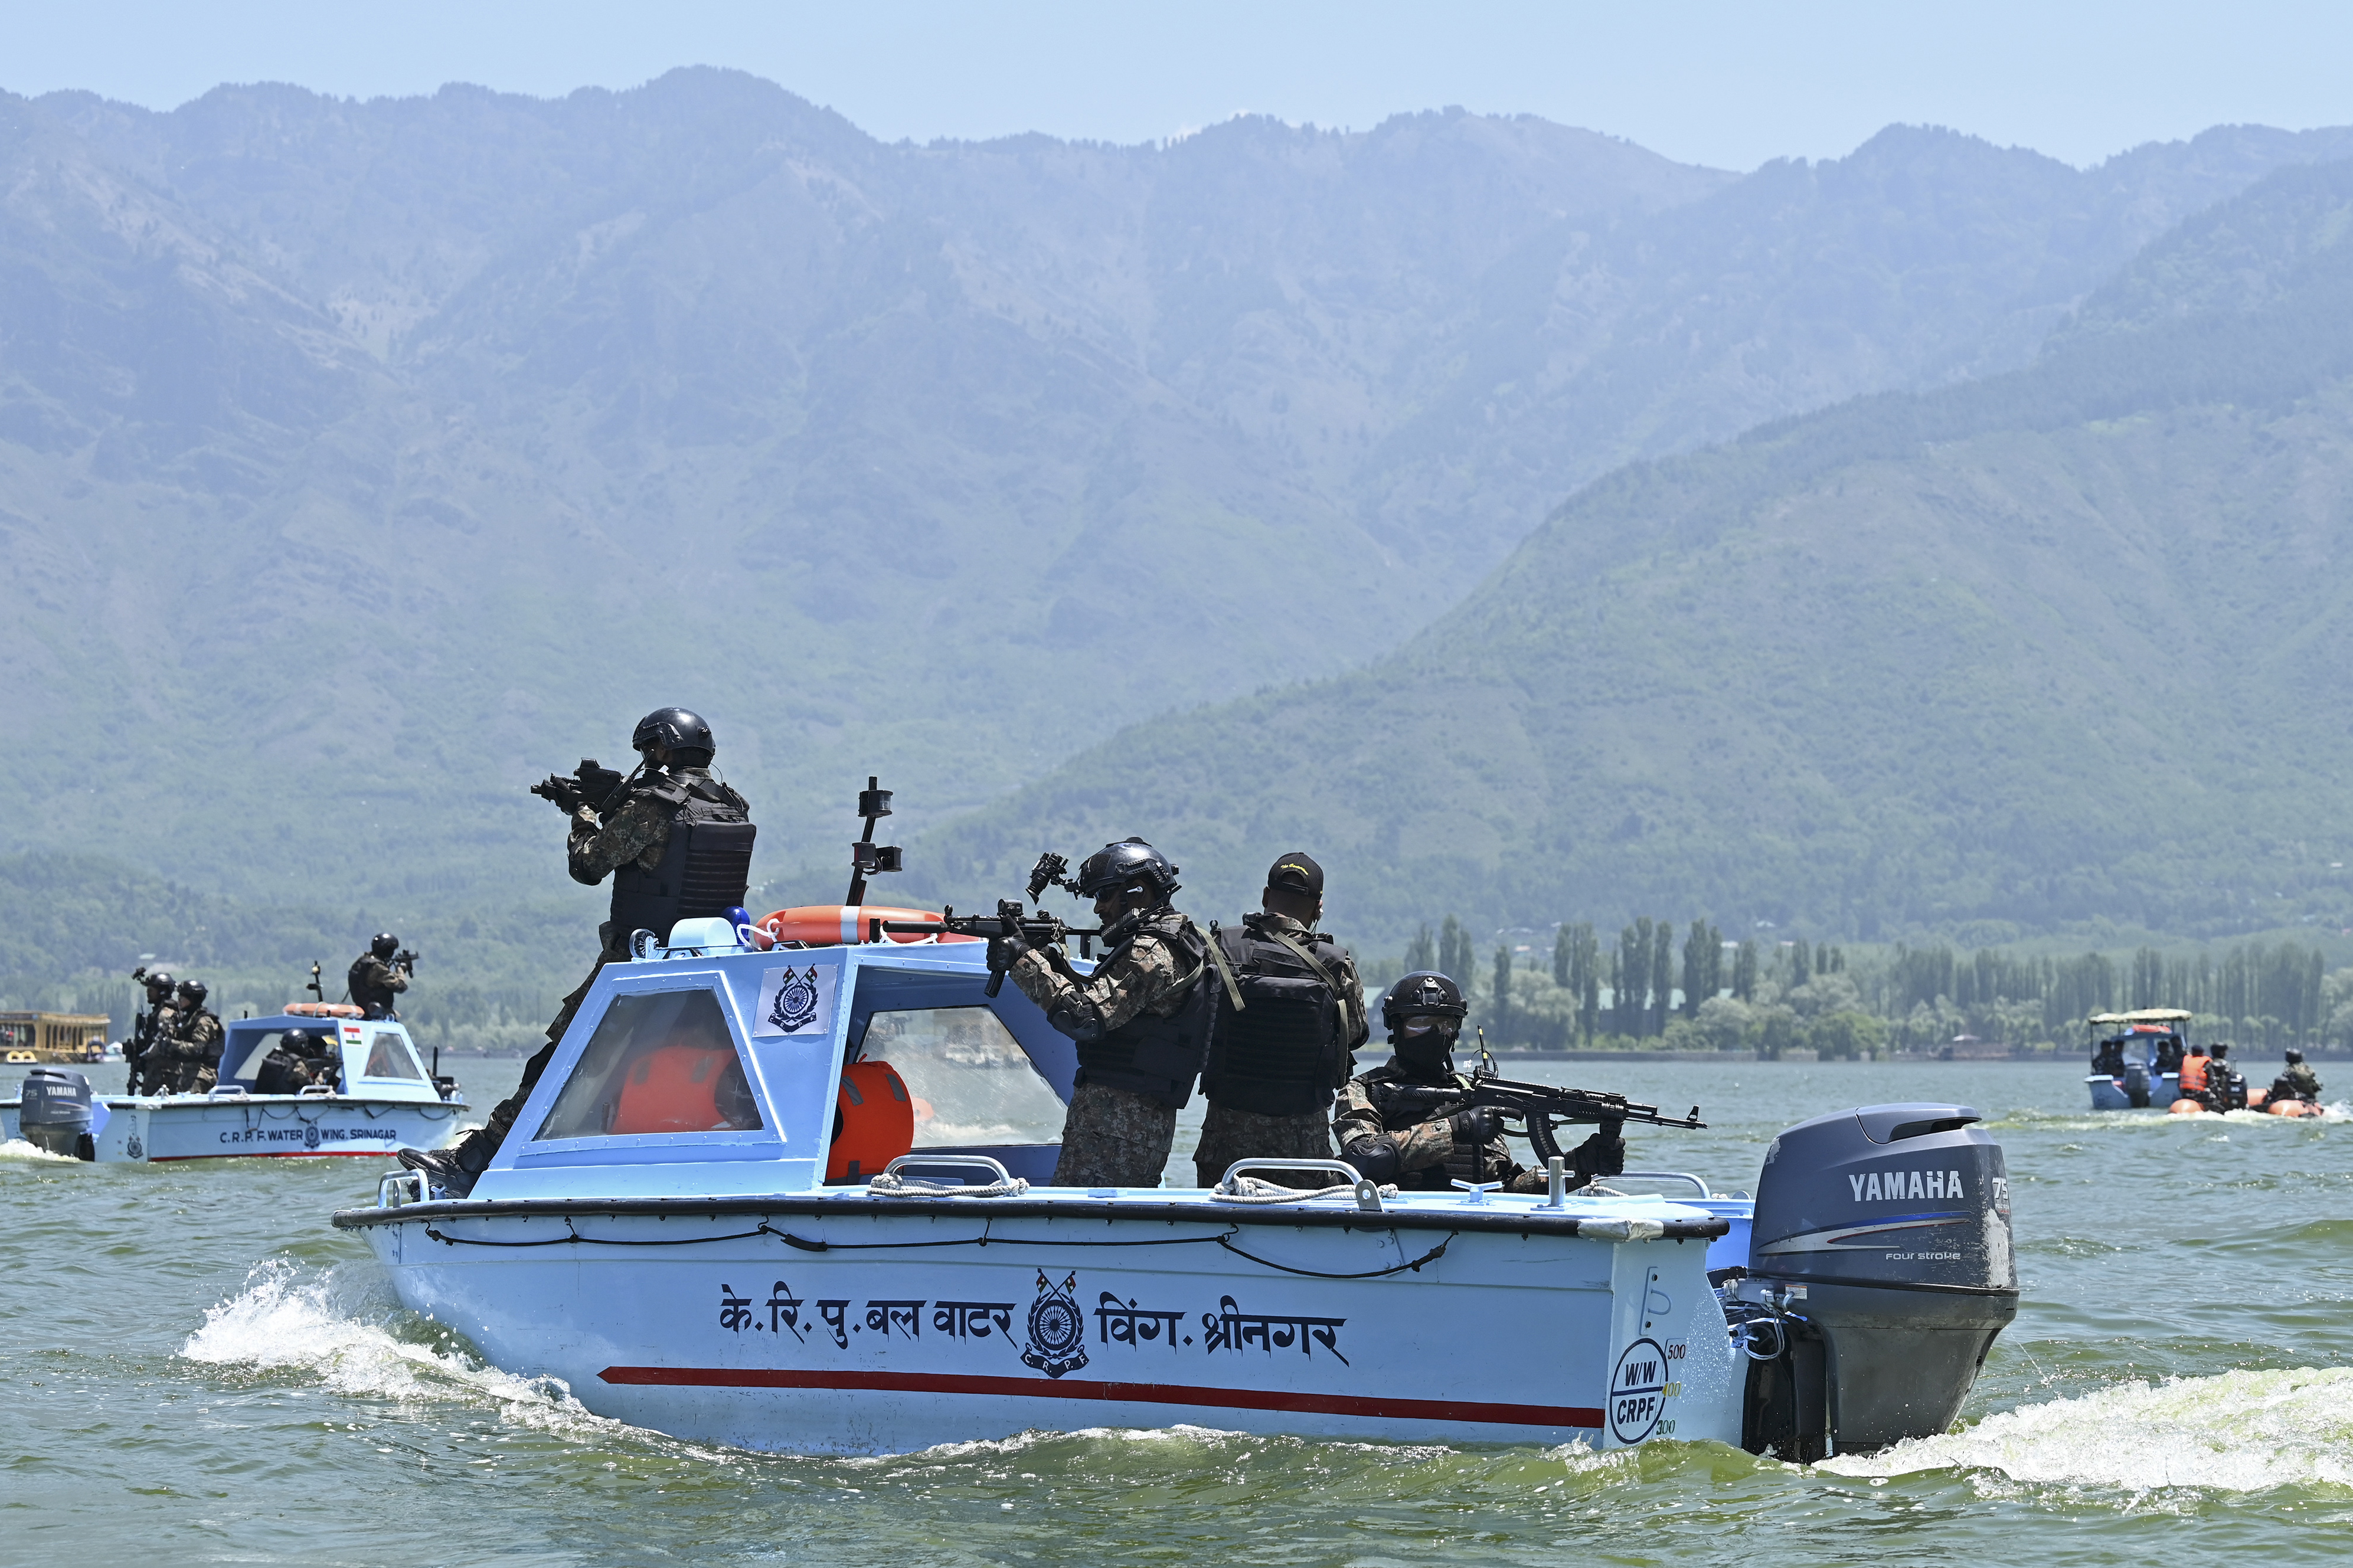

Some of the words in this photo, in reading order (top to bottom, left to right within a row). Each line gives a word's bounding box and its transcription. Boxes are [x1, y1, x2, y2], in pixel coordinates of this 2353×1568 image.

[46, 1086, 77, 1097] YAMAHA
[267, 1130, 303, 1141] WATER
[349, 1129, 397, 1140] SRINAGAR
[1848, 1170, 1964, 1202] YAMAHA
[1992, 1177, 2008, 1200] 75
[1201, 1295, 1349, 1368] श्रीनगर
[1668, 1344, 1686, 1360] 500
[1625, 1360, 1657, 1387] W/W
[1662, 1382, 1681, 1397] 400
[1617, 1396, 1655, 1425] CRPF
[1656, 1419, 1675, 1435] 300
